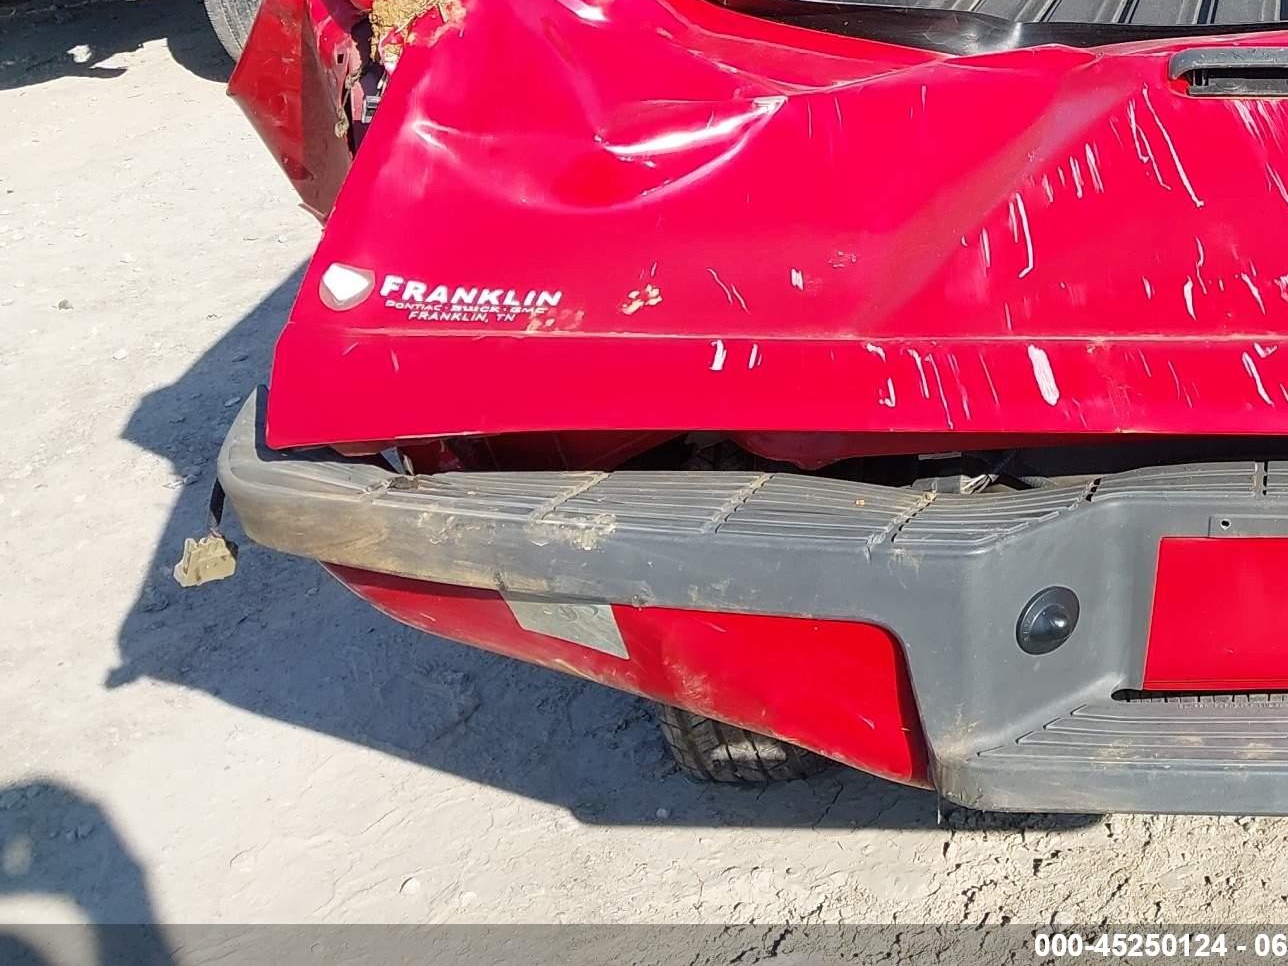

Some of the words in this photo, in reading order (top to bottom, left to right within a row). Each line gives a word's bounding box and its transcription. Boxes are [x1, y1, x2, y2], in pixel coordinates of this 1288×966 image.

[380, 274, 562, 307] FRANKLIN
[384, 299, 443, 312] PONTIAC
[450, 305, 500, 314] BUICK
[510, 306, 548, 315] GMC
[408, 310, 489, 323] FRANKLIN,
[496, 313, 516, 322] TN
